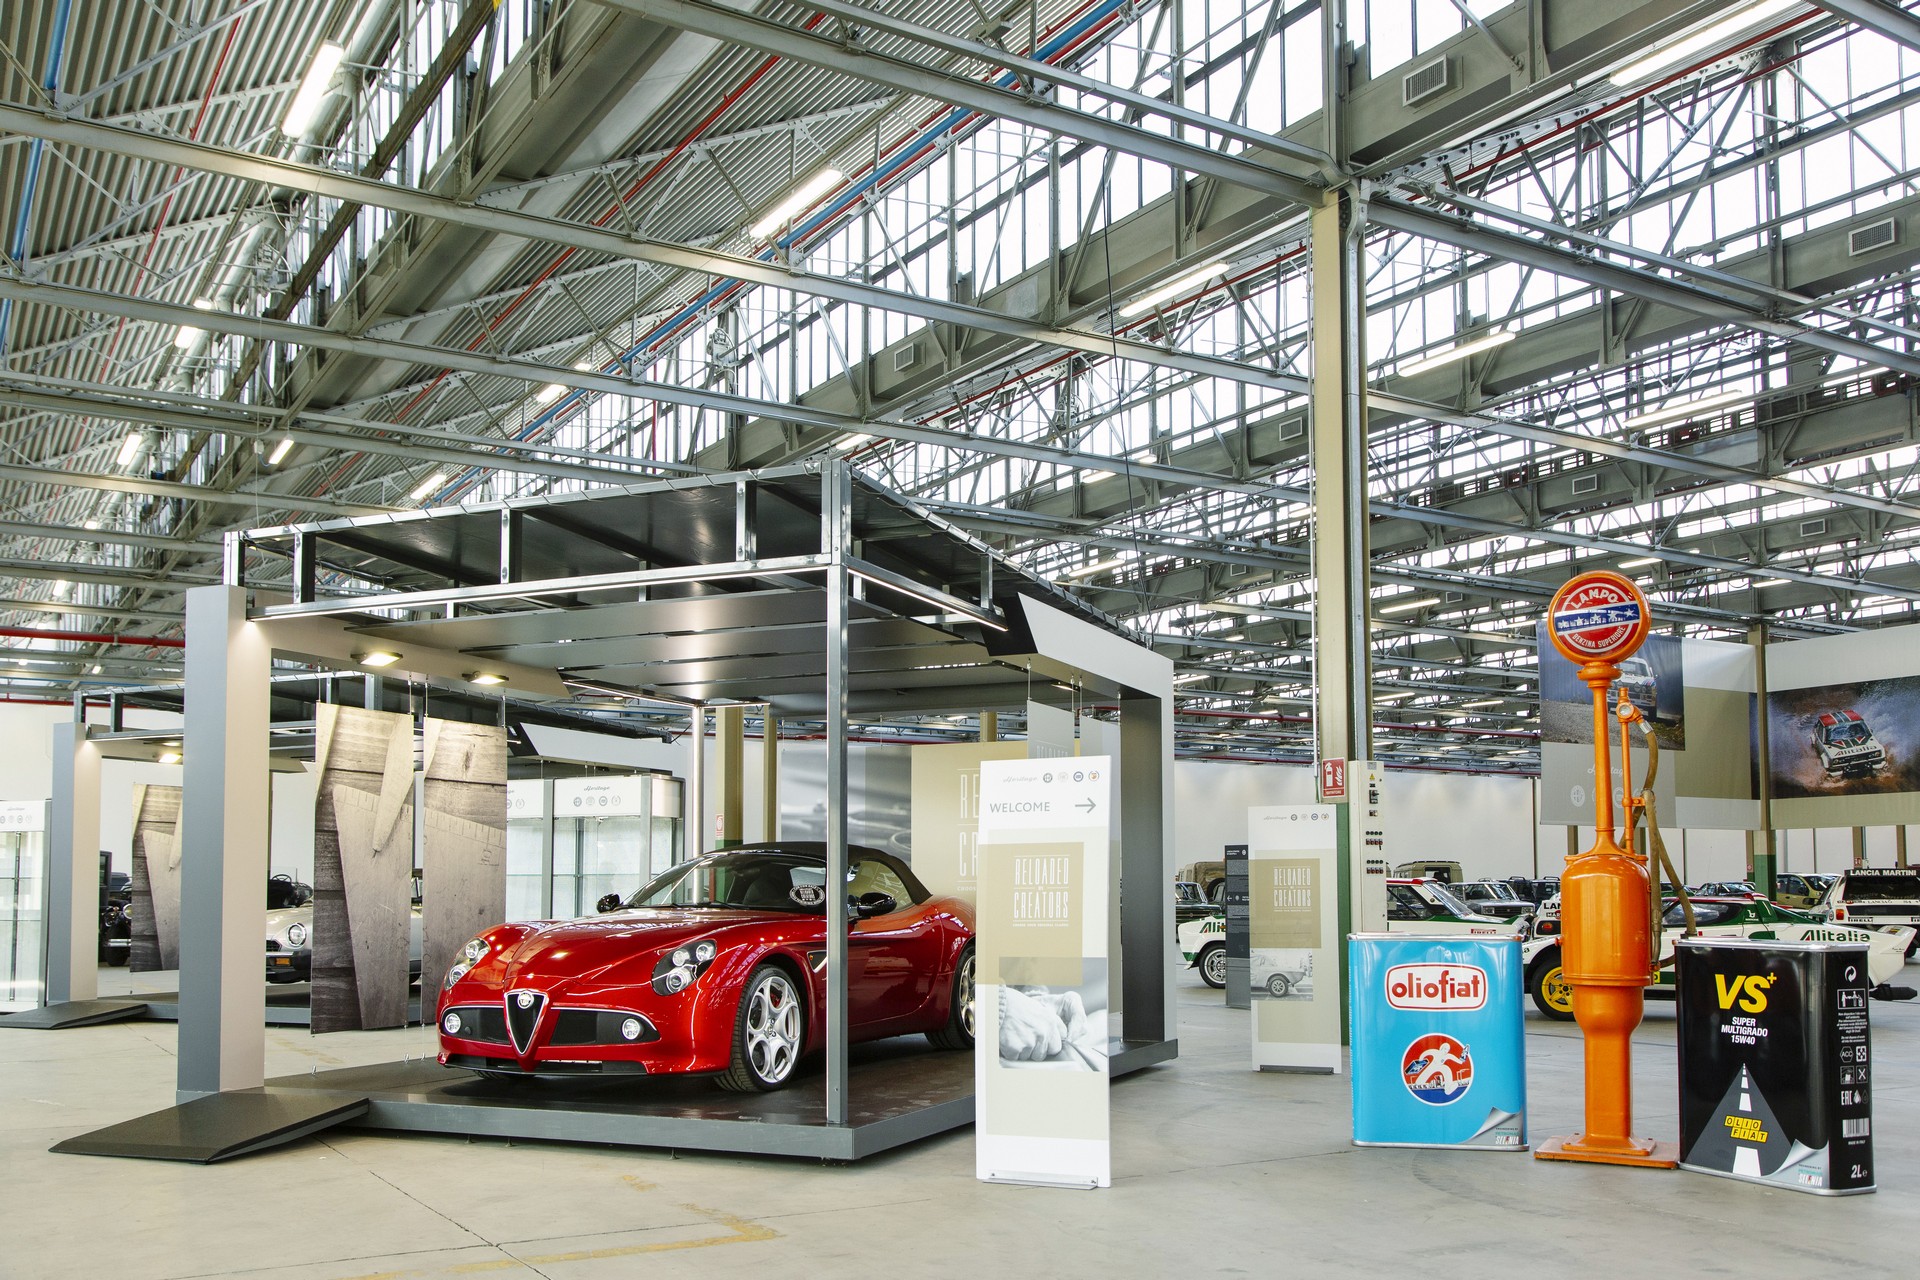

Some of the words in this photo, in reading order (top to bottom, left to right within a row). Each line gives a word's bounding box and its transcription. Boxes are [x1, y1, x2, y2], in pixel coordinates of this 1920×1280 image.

[1570, 588, 1619, 609] LAMPO
[1572, 633, 1596, 648] BENZINA
[1598, 626, 1626, 648] SUPERIORE
[989, 801, 1051, 813] WELCOME
[1014, 857, 1069, 885] RELOADED
[1273, 868, 1311, 886] RELOADED
[1013, 891, 1069, 919] CREATORS
[1273, 889, 1311, 907] CREATORS
[1199, 922, 1226, 933] Alit
[1800, 929, 1871, 942] Alitalia
[1391, 970, 1480, 1003] oliofiat
[1731, 1016, 1757, 1027] SUPER
[1721, 1024, 1768, 1037] MULTIGRADO
[1731, 1034, 1756, 1045] 15W40
[1726, 1117, 1759, 1129] OLIO
[1733, 1129, 1765, 1140] FIAT
[1850, 1164, 1862, 1179] 2L
